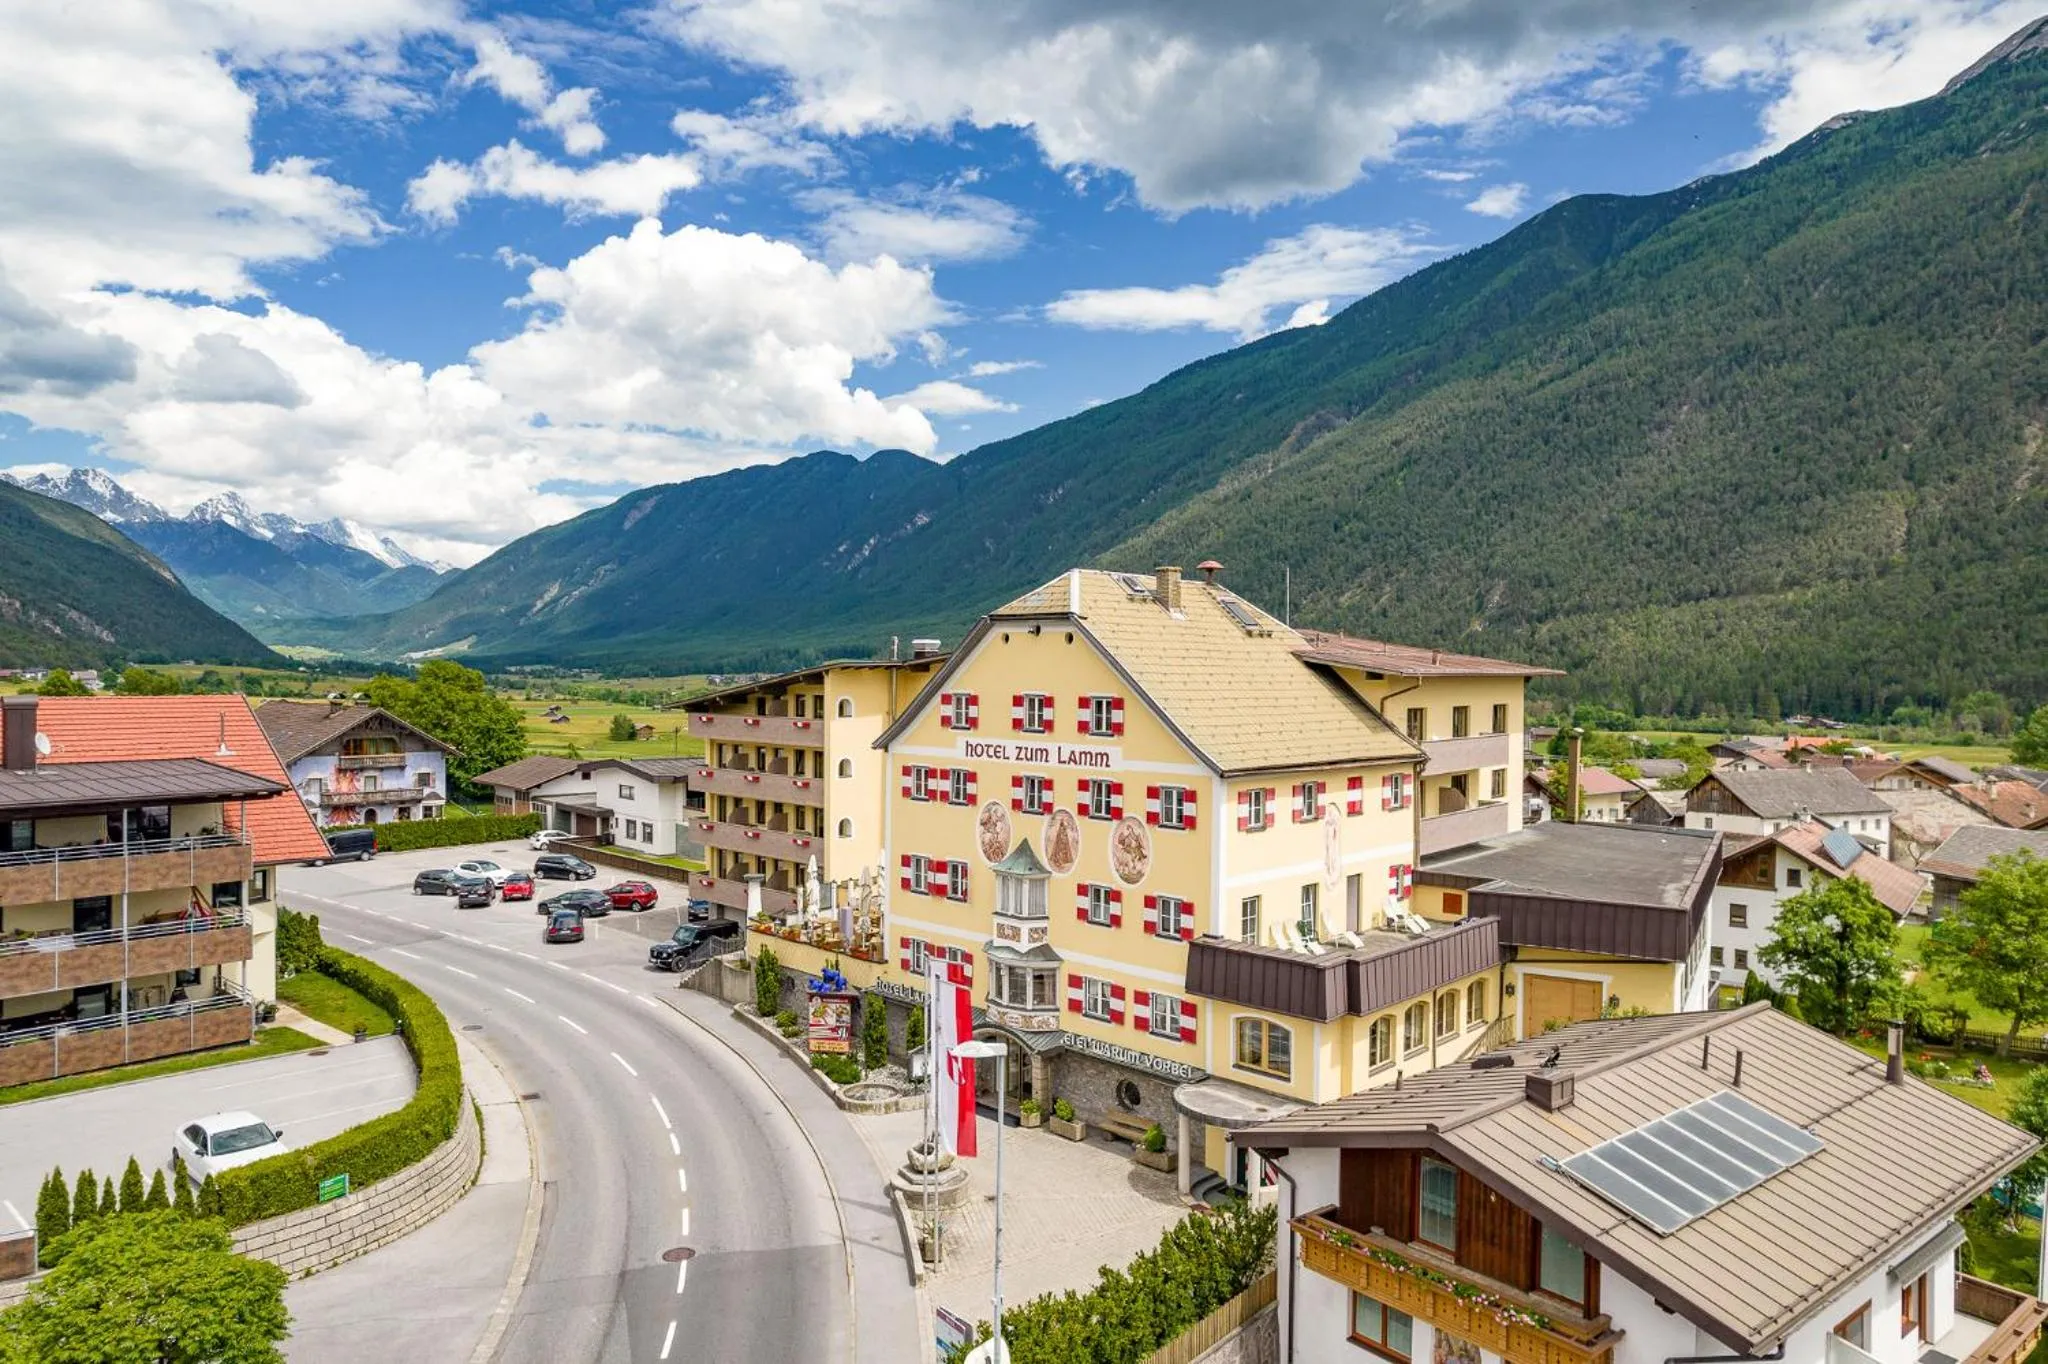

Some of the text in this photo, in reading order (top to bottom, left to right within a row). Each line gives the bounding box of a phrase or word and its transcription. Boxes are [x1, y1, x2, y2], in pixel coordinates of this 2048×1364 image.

[965, 740, 1111, 768] HOTEL ZUM LAMM
[1091, 1040, 1140, 1065] WARUM
[1144, 1054, 1192, 1078] VORBEI
